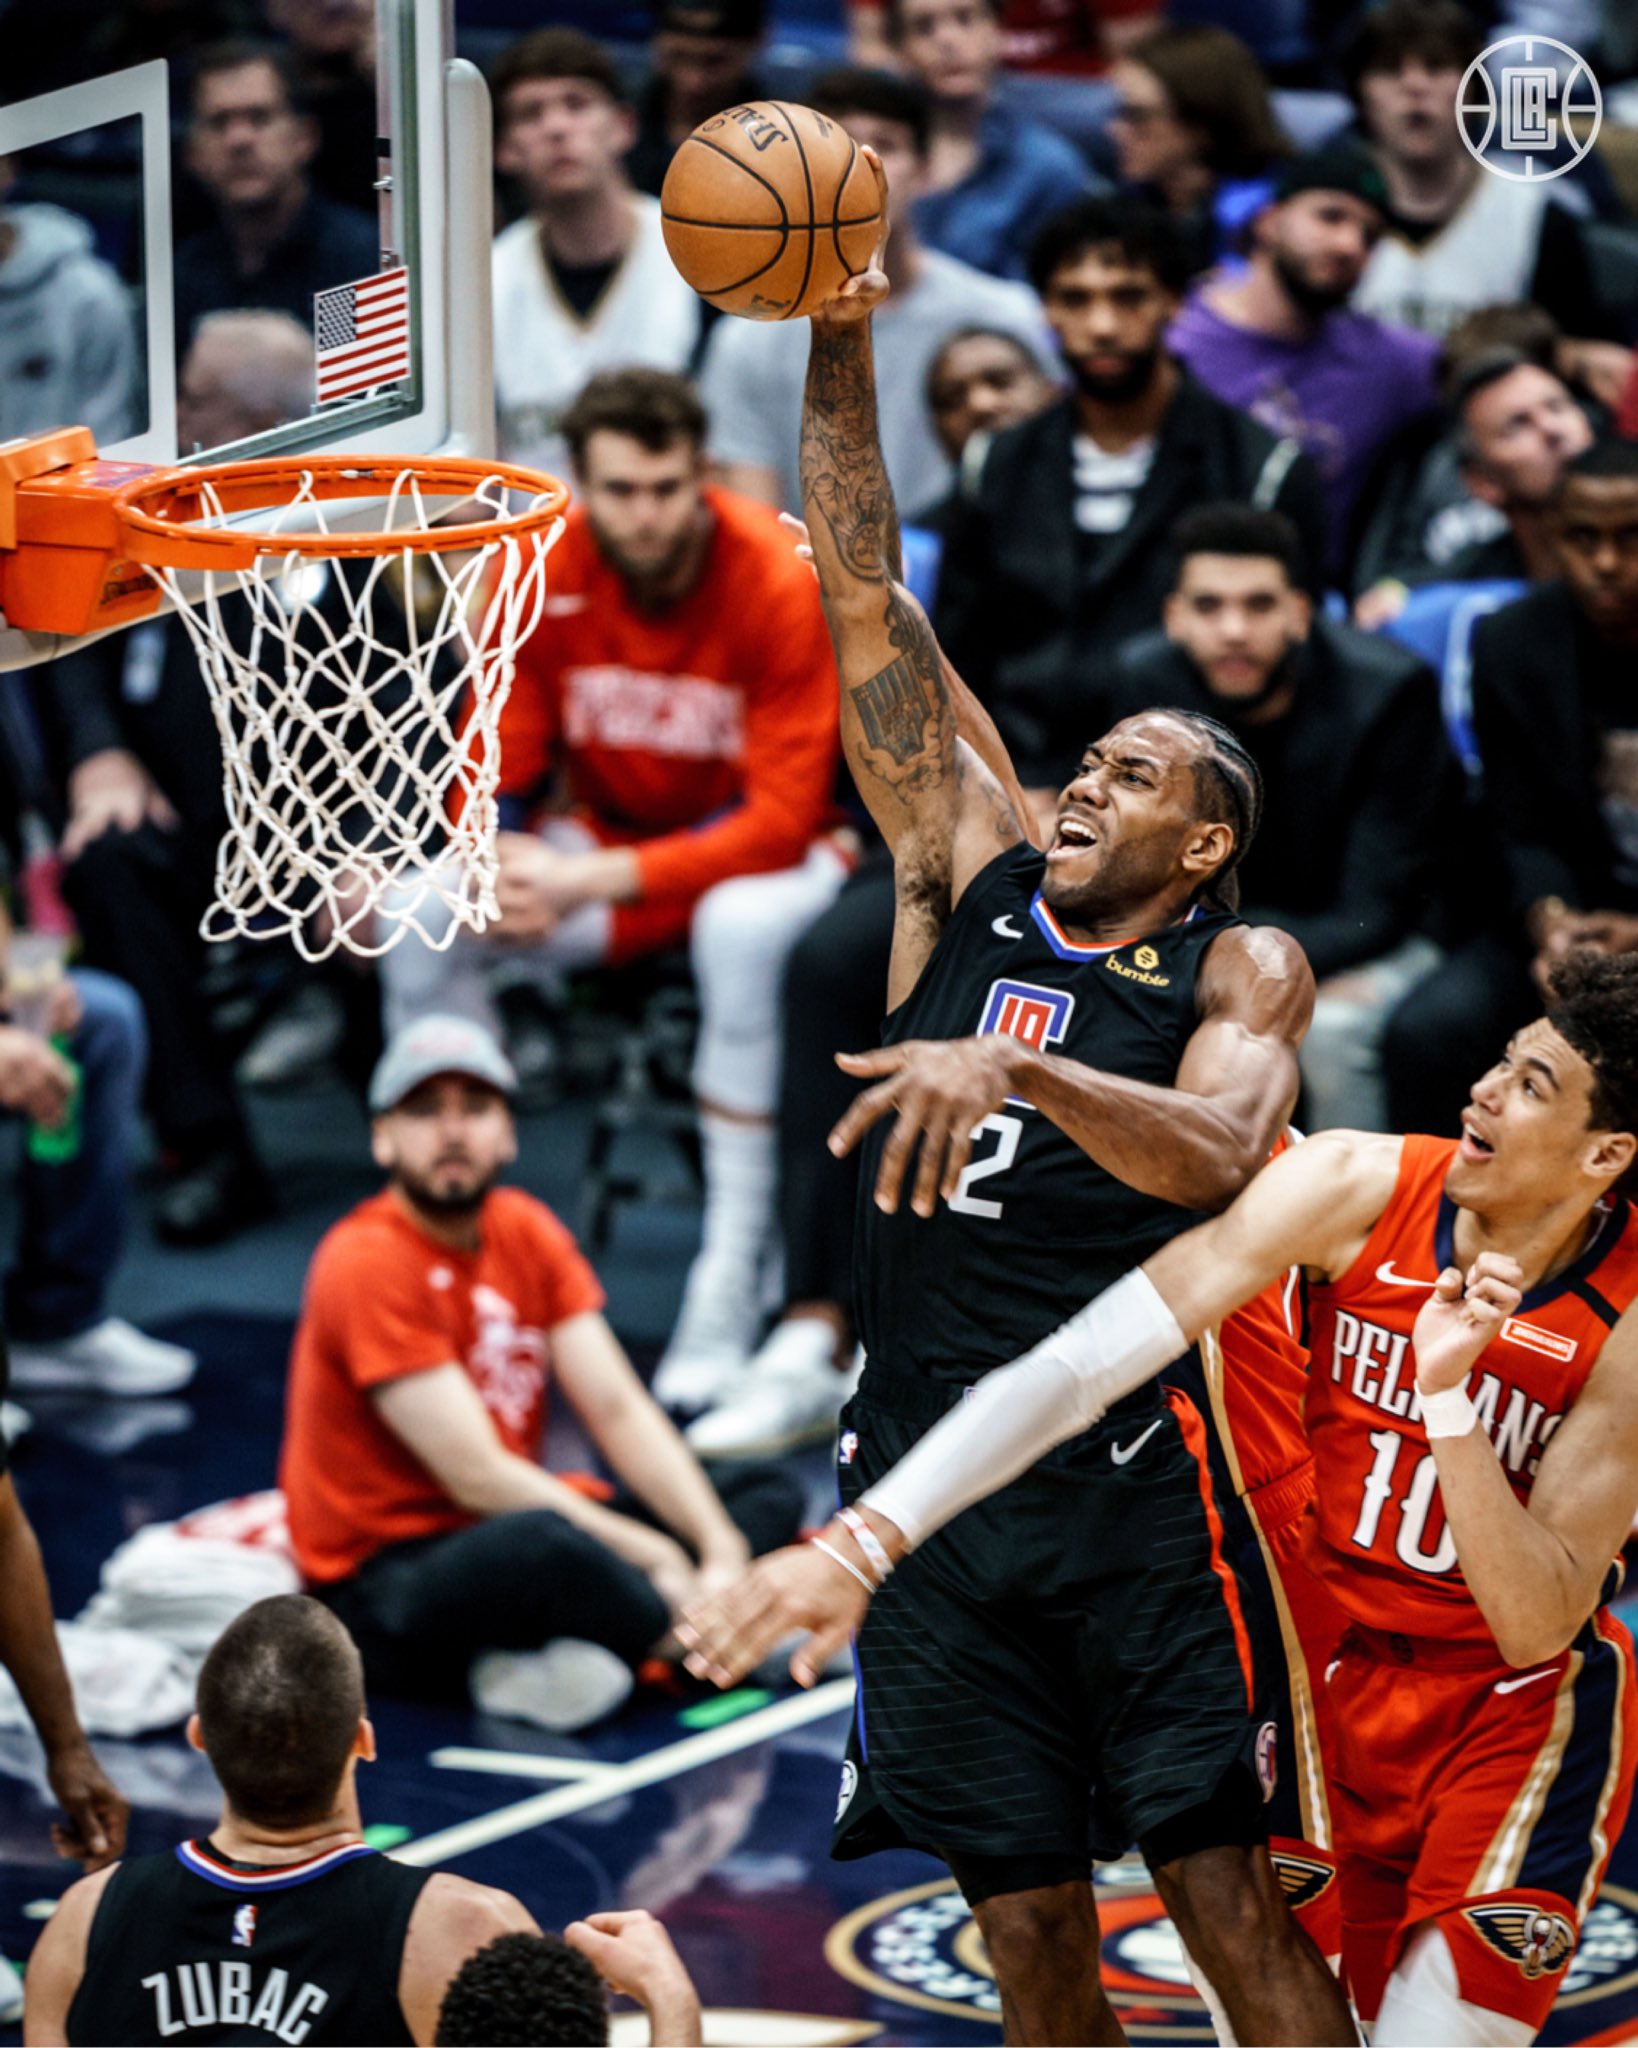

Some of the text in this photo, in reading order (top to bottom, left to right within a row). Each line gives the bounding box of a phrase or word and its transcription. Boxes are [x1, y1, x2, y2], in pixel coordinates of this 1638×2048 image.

[1105, 954, 1169, 987] bumble
[948, 1112, 1023, 1220] 2
[1351, 1429, 1458, 1573] 10
[141, 1960, 329, 2046] ZUBAC
